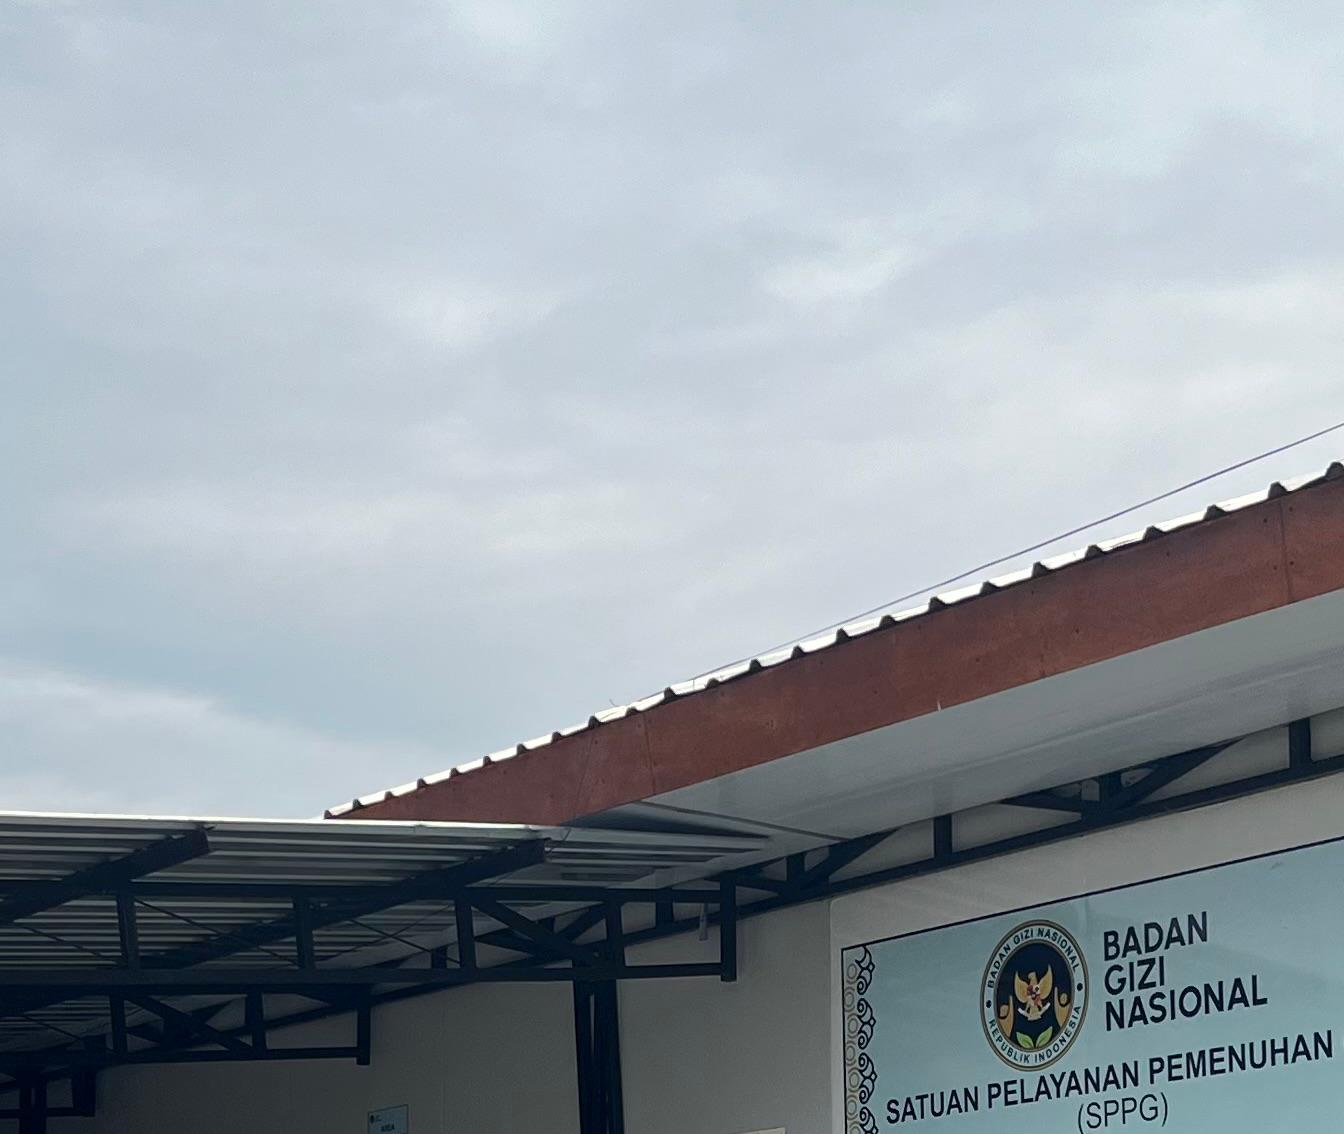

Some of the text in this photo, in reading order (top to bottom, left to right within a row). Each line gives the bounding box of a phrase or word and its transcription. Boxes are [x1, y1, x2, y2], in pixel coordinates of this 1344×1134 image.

[987, 927, 1080, 989] BADAN GIZI NASIONAL
[1103, 911, 1207, 961] BADAN
[1104, 955, 1165, 995] GIZI
[1105, 975, 1268, 1032] NASIONAL
[988, 1005, 1082, 1064] REPUBLIK INDONESIA
[886, 1086, 979, 1124] SATUAN
[987, 1060, 1139, 1109] PELAYANAN
[1149, 1030, 1333, 1084] PEMENUHAN
